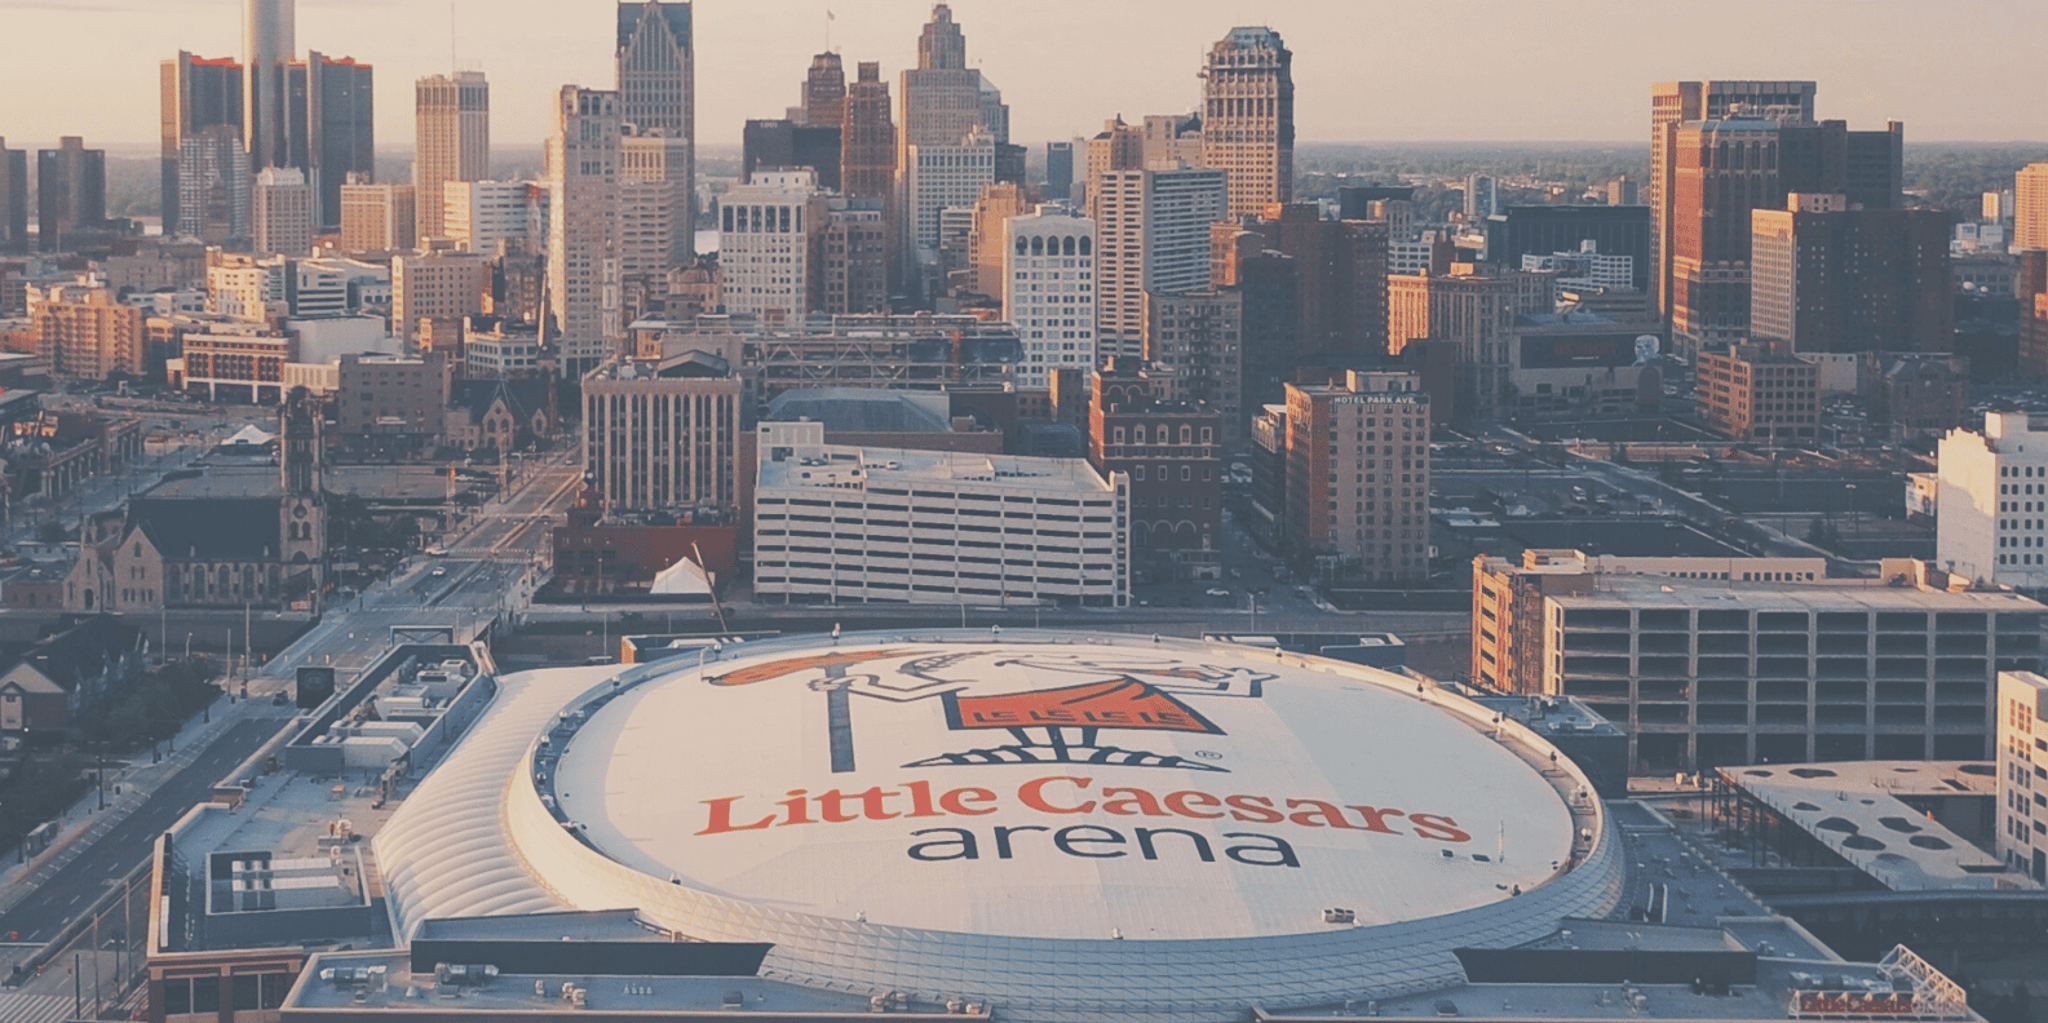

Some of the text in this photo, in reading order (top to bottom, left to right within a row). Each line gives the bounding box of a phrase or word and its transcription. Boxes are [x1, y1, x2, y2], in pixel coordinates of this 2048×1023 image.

[1334, 396, 1366, 404] HOTEL
[1367, 396, 1393, 404] PARK
[693, 775, 1471, 843] Little Caesars
[907, 824, 1301, 868] arena
